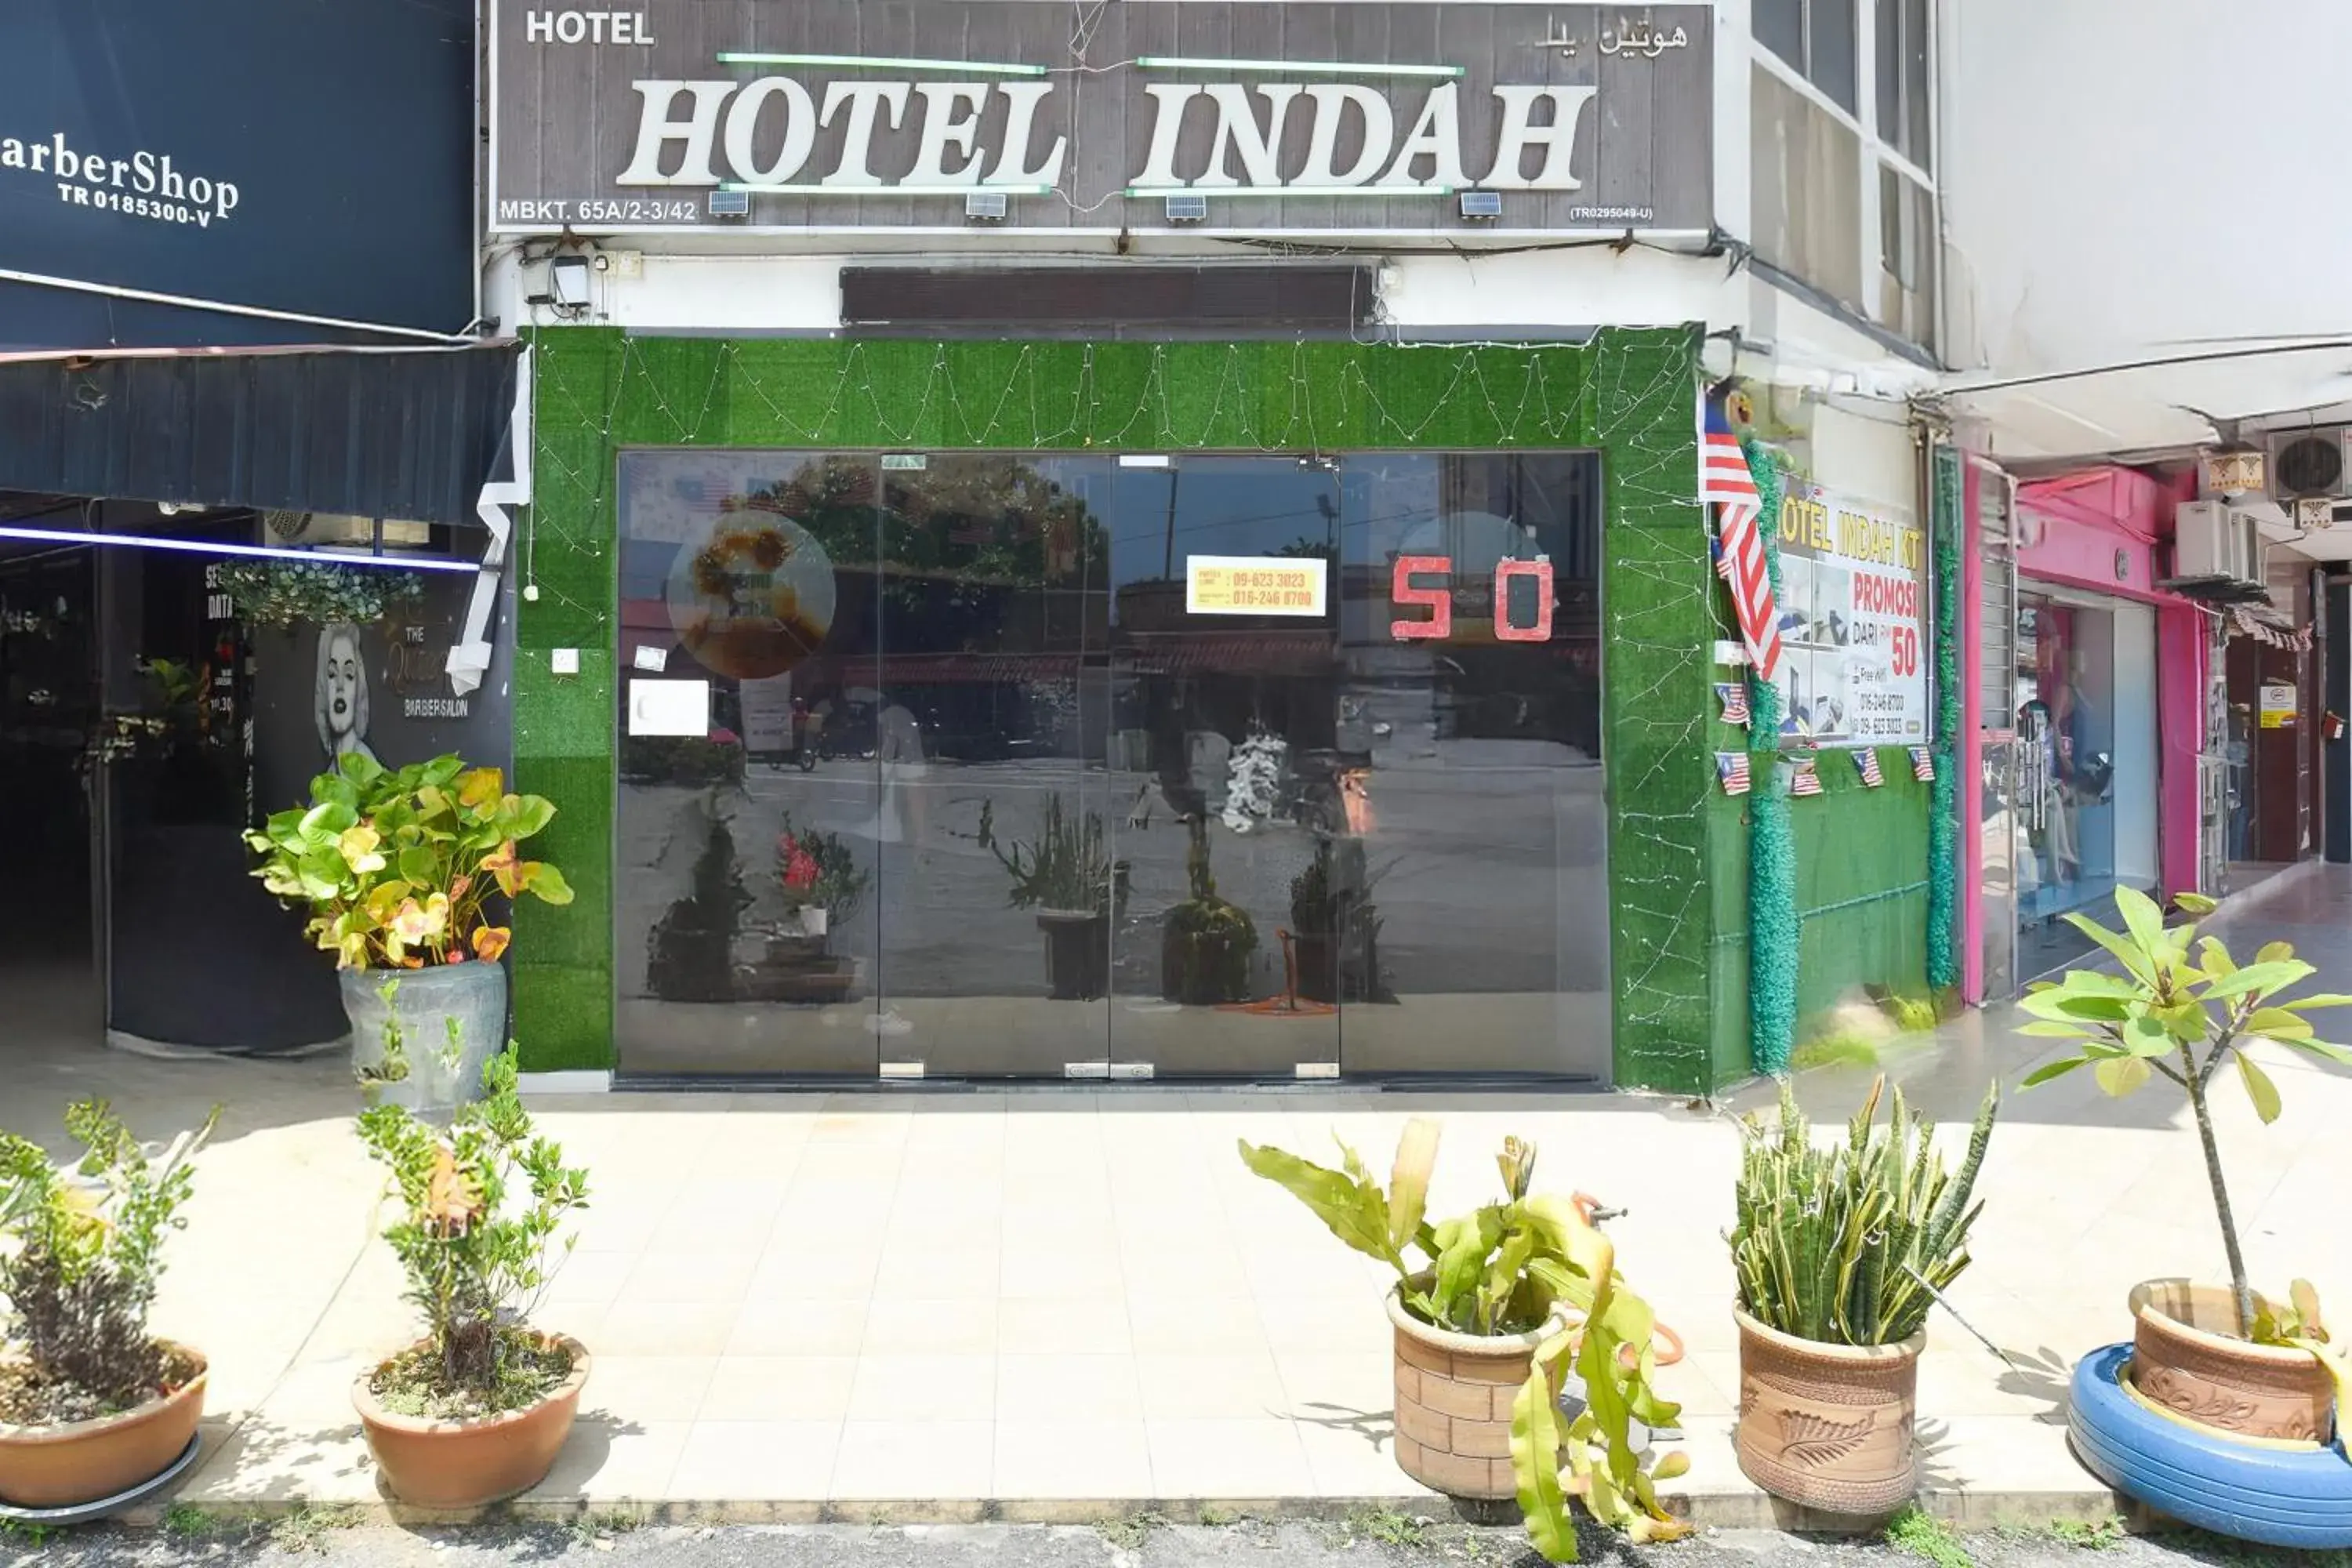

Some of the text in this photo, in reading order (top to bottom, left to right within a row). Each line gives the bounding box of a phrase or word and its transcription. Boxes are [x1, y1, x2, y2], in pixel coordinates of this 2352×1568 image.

[527, 11, 654, 45] HOTEL
[616, 76, 1597, 191] HOTEL INDAH
[499, 201, 696, 220] MBKT. 65A/2-3/42
[1778, 496, 1833, 554] OTEL
[1838, 510, 1895, 566] INDAH
[1232, 572, 1274, 587] 09-623
[1853, 571, 1918, 619] PROMOSI
[405, 626, 424, 642] THE
[1853, 621, 1878, 646] DARI
[1892, 626, 1917, 677] 50
